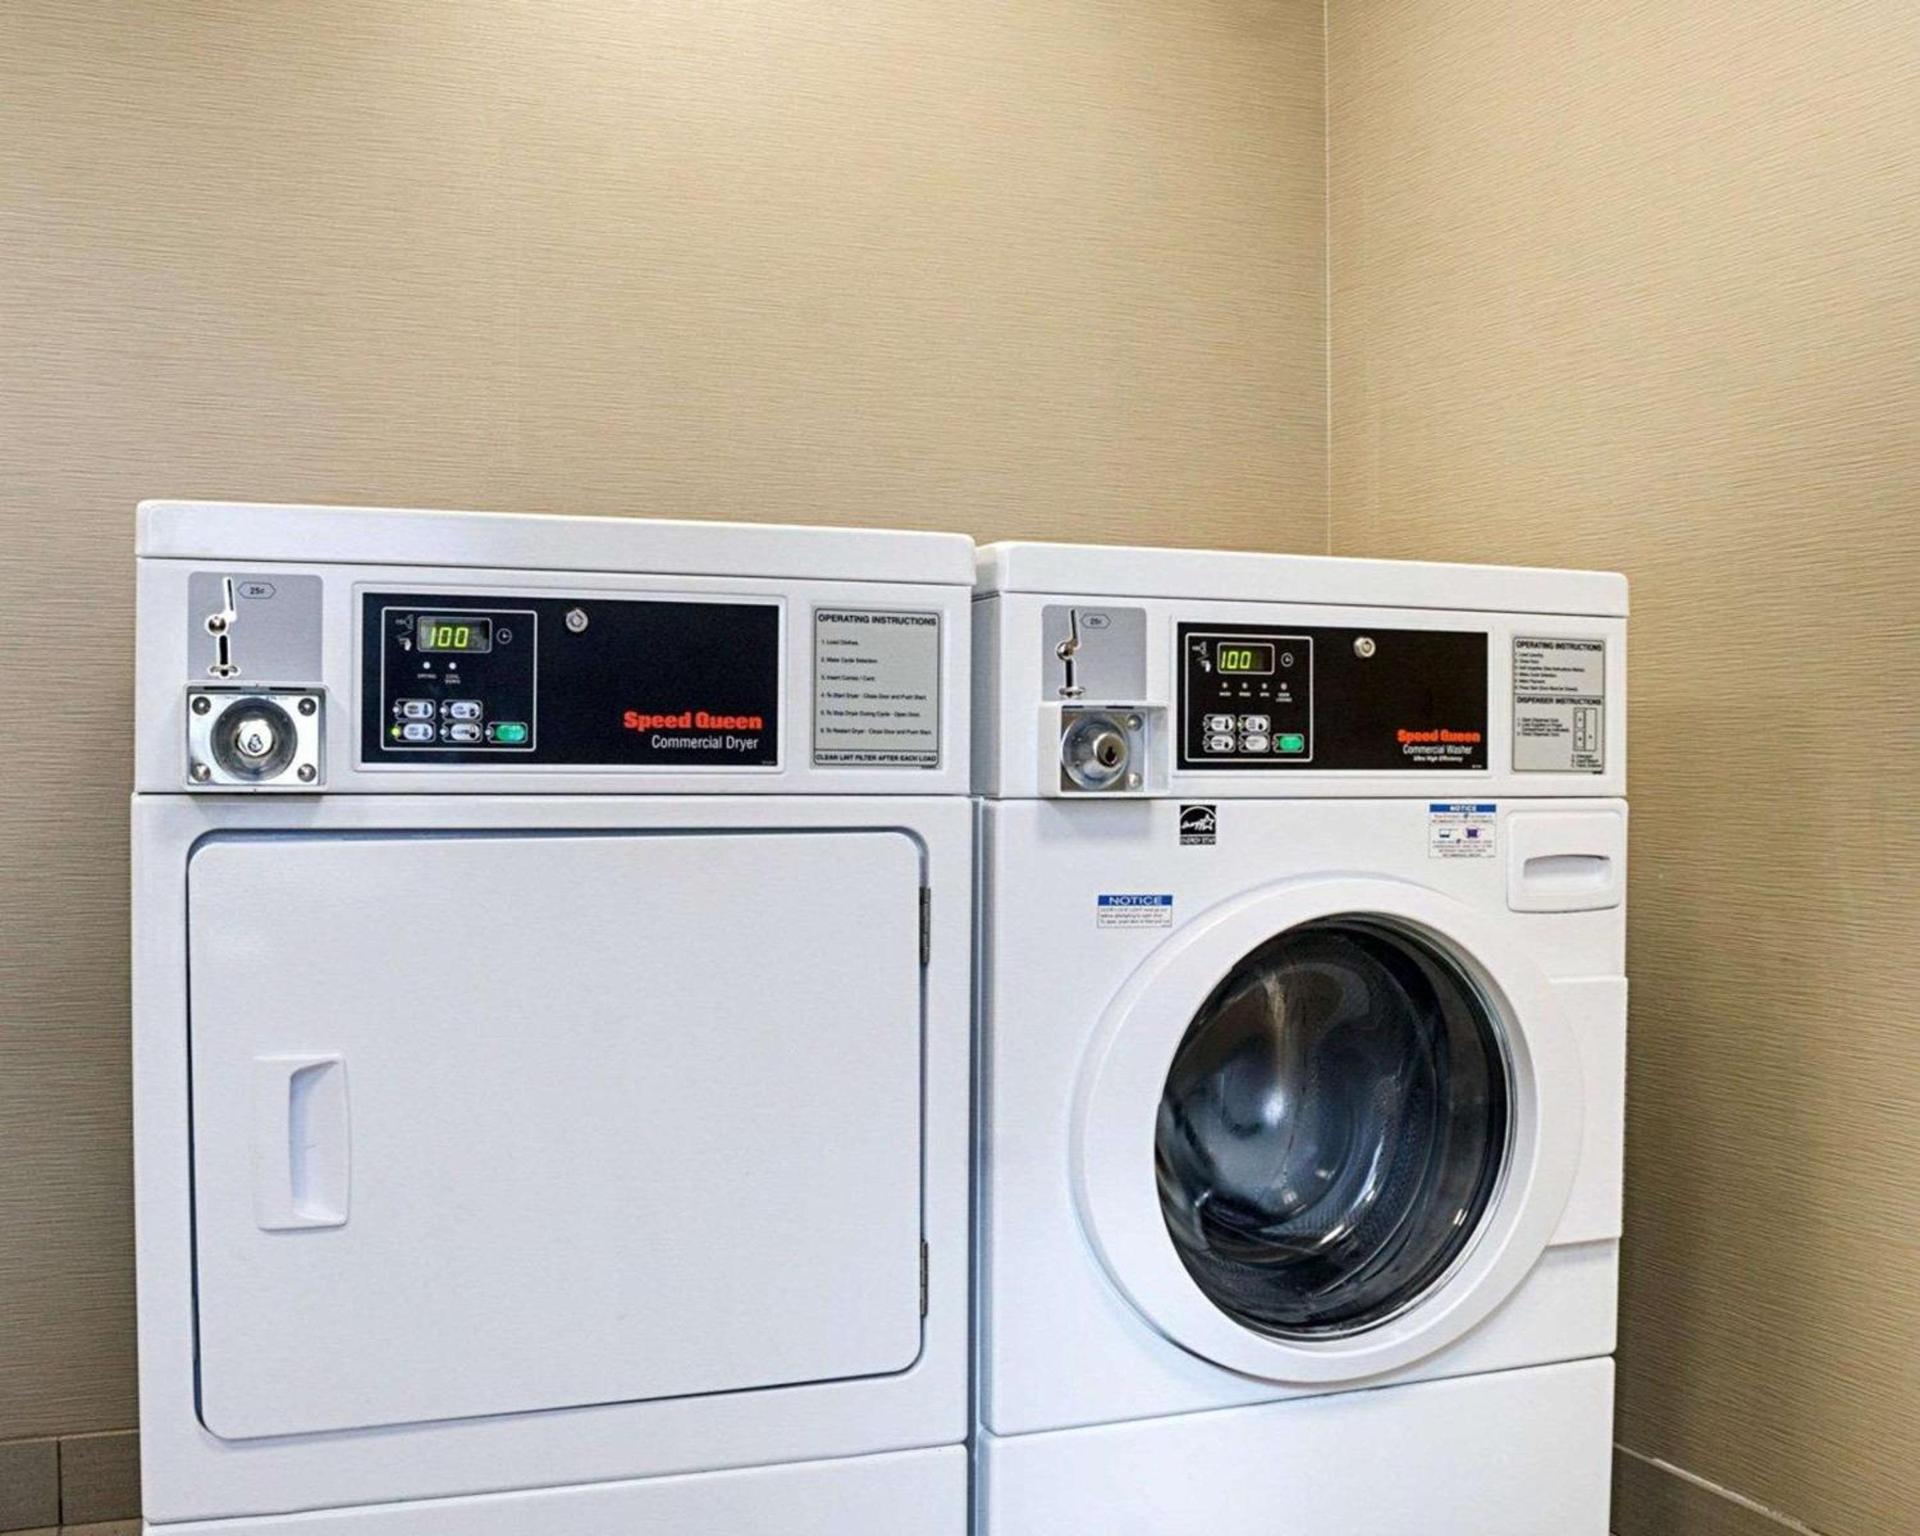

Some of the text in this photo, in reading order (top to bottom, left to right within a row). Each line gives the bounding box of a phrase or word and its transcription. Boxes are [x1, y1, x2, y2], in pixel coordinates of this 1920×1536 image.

[818, 614, 937, 626] OPERATING INSTRUCTIONS
[429, 626, 469, 648] 100
[1220, 650, 1252, 670] 100
[623, 710, 763, 732] Speed Queen
[651, 735, 759, 752] Commercial Dryer
[1397, 729, 1481, 744] Speed Queen
[1403, 744, 1473, 755] Commercial Washer
[1108, 896, 1162, 905] NOTICE
